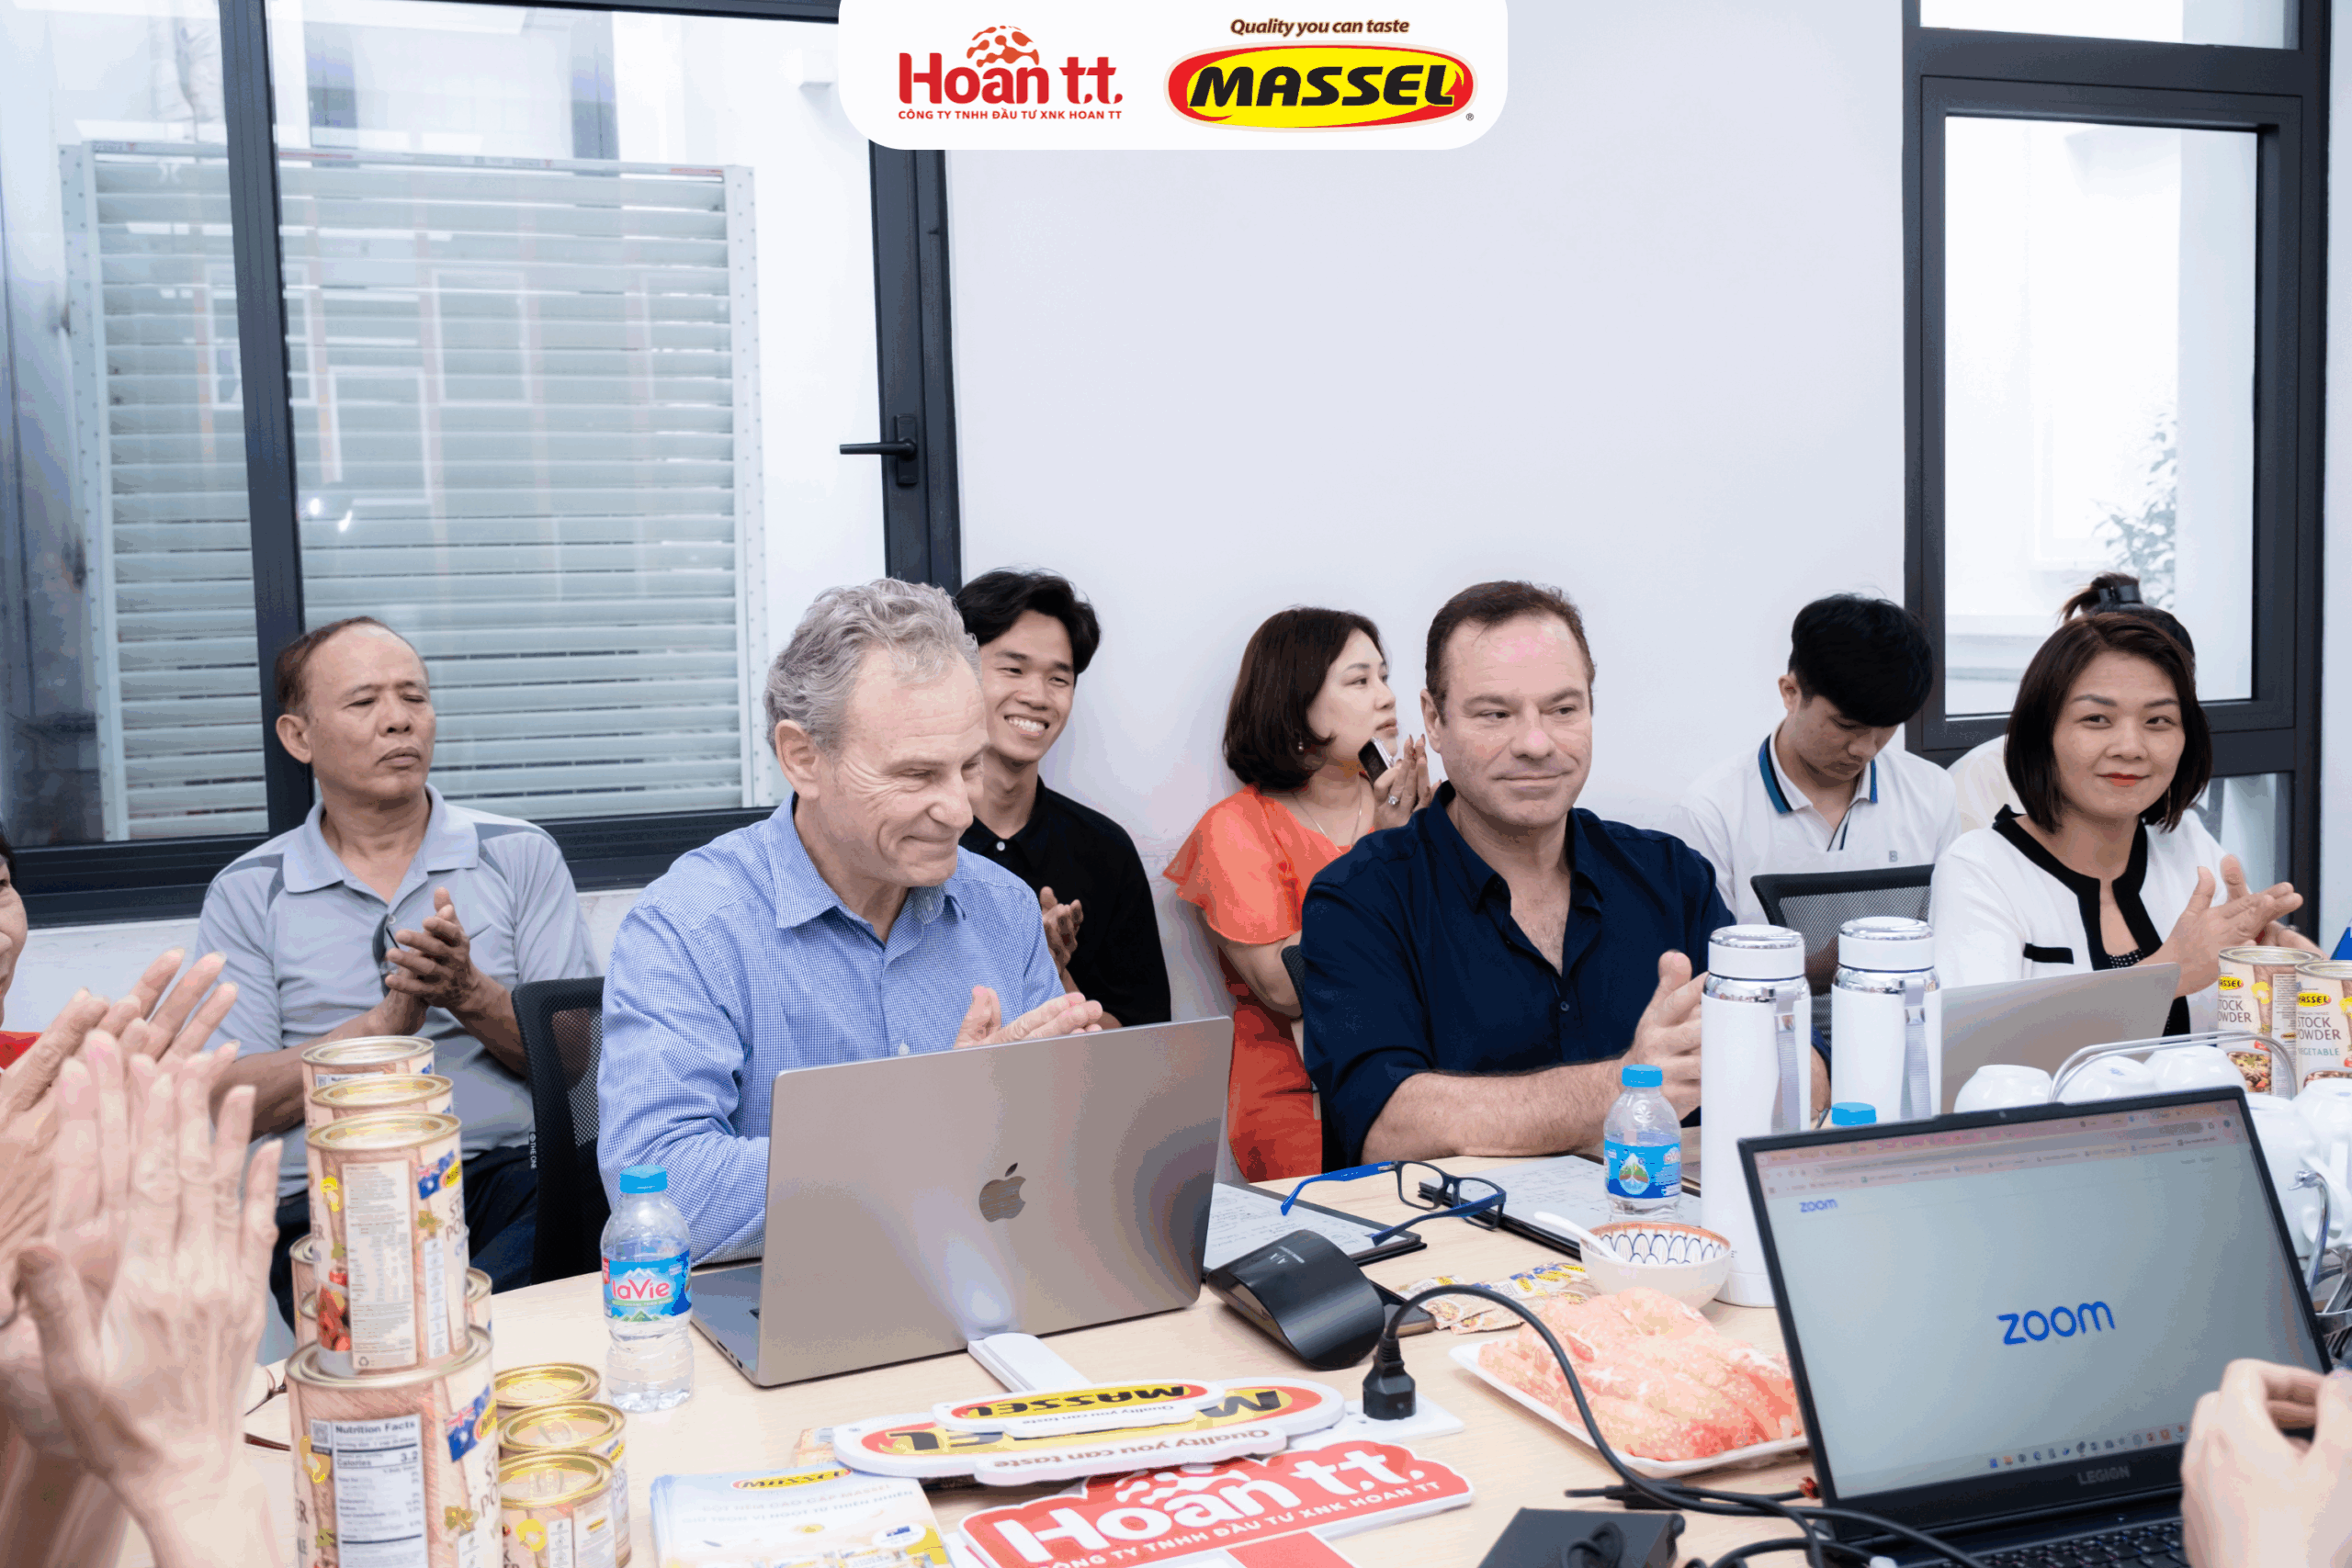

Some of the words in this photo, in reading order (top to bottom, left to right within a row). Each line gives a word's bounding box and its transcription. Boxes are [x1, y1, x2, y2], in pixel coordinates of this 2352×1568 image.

[1799, 1198, 1838, 1213] zoom
[1996, 1301, 2115, 1345] zoom
[966, 1385, 1185, 1417] MASSEL
[1098, 1409, 1120, 1417] you
[1122, 1404, 1174, 1415] Quality
[335, 1424, 381, 1435] Nutrition
[385, 1420, 416, 1431] Facts
[1175, 1429, 1270, 1449] Quality
[1067, 1448, 1115, 1461] can
[1120, 1440, 1171, 1455] you
[993, 1455, 1063, 1469] taste
[2076, 1465, 2131, 1485] LEGION
[993, 1479, 1303, 1563] Hoan
[1110, 1546, 1138, 1561] TY
[1143, 1531, 1209, 1552] TNHH
[1298, 1502, 1347, 1519] XNK
[1349, 1487, 1413, 1507] HOAN
[1414, 1481, 1441, 1494] TT
